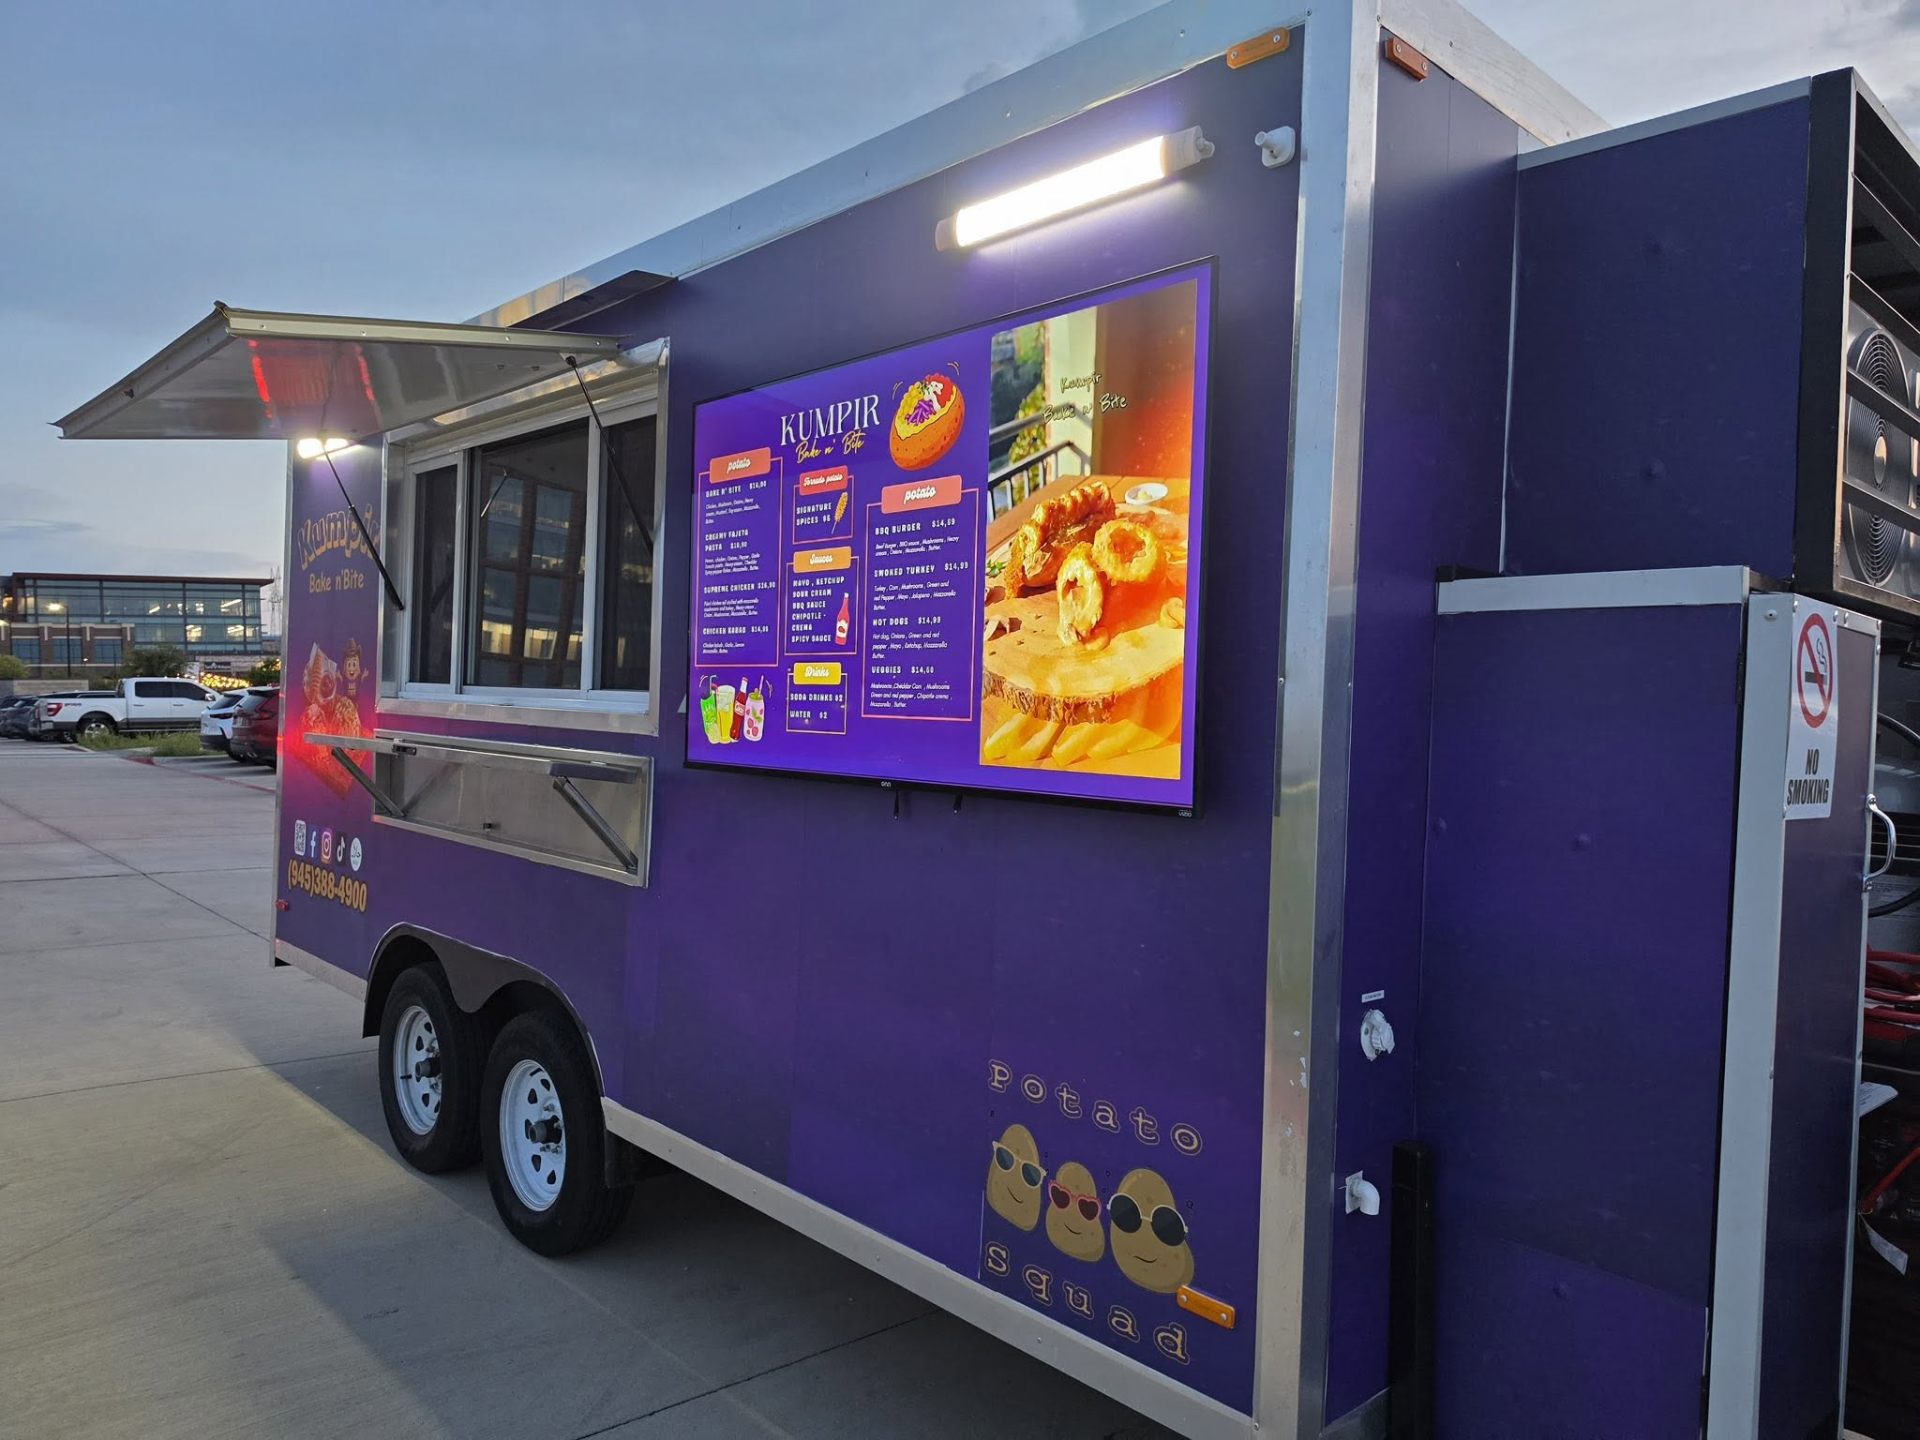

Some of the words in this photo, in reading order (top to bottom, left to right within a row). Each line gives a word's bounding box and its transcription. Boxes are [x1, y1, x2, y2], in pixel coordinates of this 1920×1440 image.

[1100, 393, 1128, 413] Bite
[780, 394, 880, 446] KUMPIR
[796, 438, 822, 464] Bake
[842, 429, 867, 455] Bite
[726, 457, 752, 474] potato
[826, 472, 843, 485] potato
[904, 485, 936, 505] potato
[796, 502, 832, 514] SIGNATURE
[796, 516, 819, 526] SPICES
[875, 526, 890, 536] BBQ
[892, 522, 921, 534] BURGER
[298, 504, 380, 571] Kumpir
[705, 530, 727, 541] CREAMY
[704, 544, 722, 552] PASTA
[810, 554, 833, 565] Sauces
[874, 568, 903, 578] SMOKED
[906, 564, 936, 575] TURKEY
[309, 572, 332, 594] Bake
[793, 579, 810, 587] MAYO
[816, 576, 844, 586] KETCHUP
[704, 585, 729, 594] SUPREME
[730, 583, 755, 592] CHICKEN
[793, 590, 809, 598] SOUR
[811, 588, 832, 597] CREAM
[792, 602, 805, 610] BBQ
[807, 600, 826, 608] SAUCE
[792, 612, 822, 620] CHIPOTLE
[872, 618, 887, 626] HOT
[890, 618, 908, 626] DOGS
[702, 627, 726, 635] CHICKEN
[792, 624, 812, 632] CREMA
[804, 666, 830, 677] Drinks
[872, 666, 902, 674] VEGGIES
[790, 693, 807, 701] SODA
[808, 694, 833, 702] DRINKS
[790, 710, 811, 718] WATER
[819, 711, 828, 719] $2
[1806, 748, 1820, 776] NO
[1786, 778, 1830, 804] SMOKING
[288, 859, 367, 912] (945)388-4900
[985, 1241, 1191, 1366] squad
